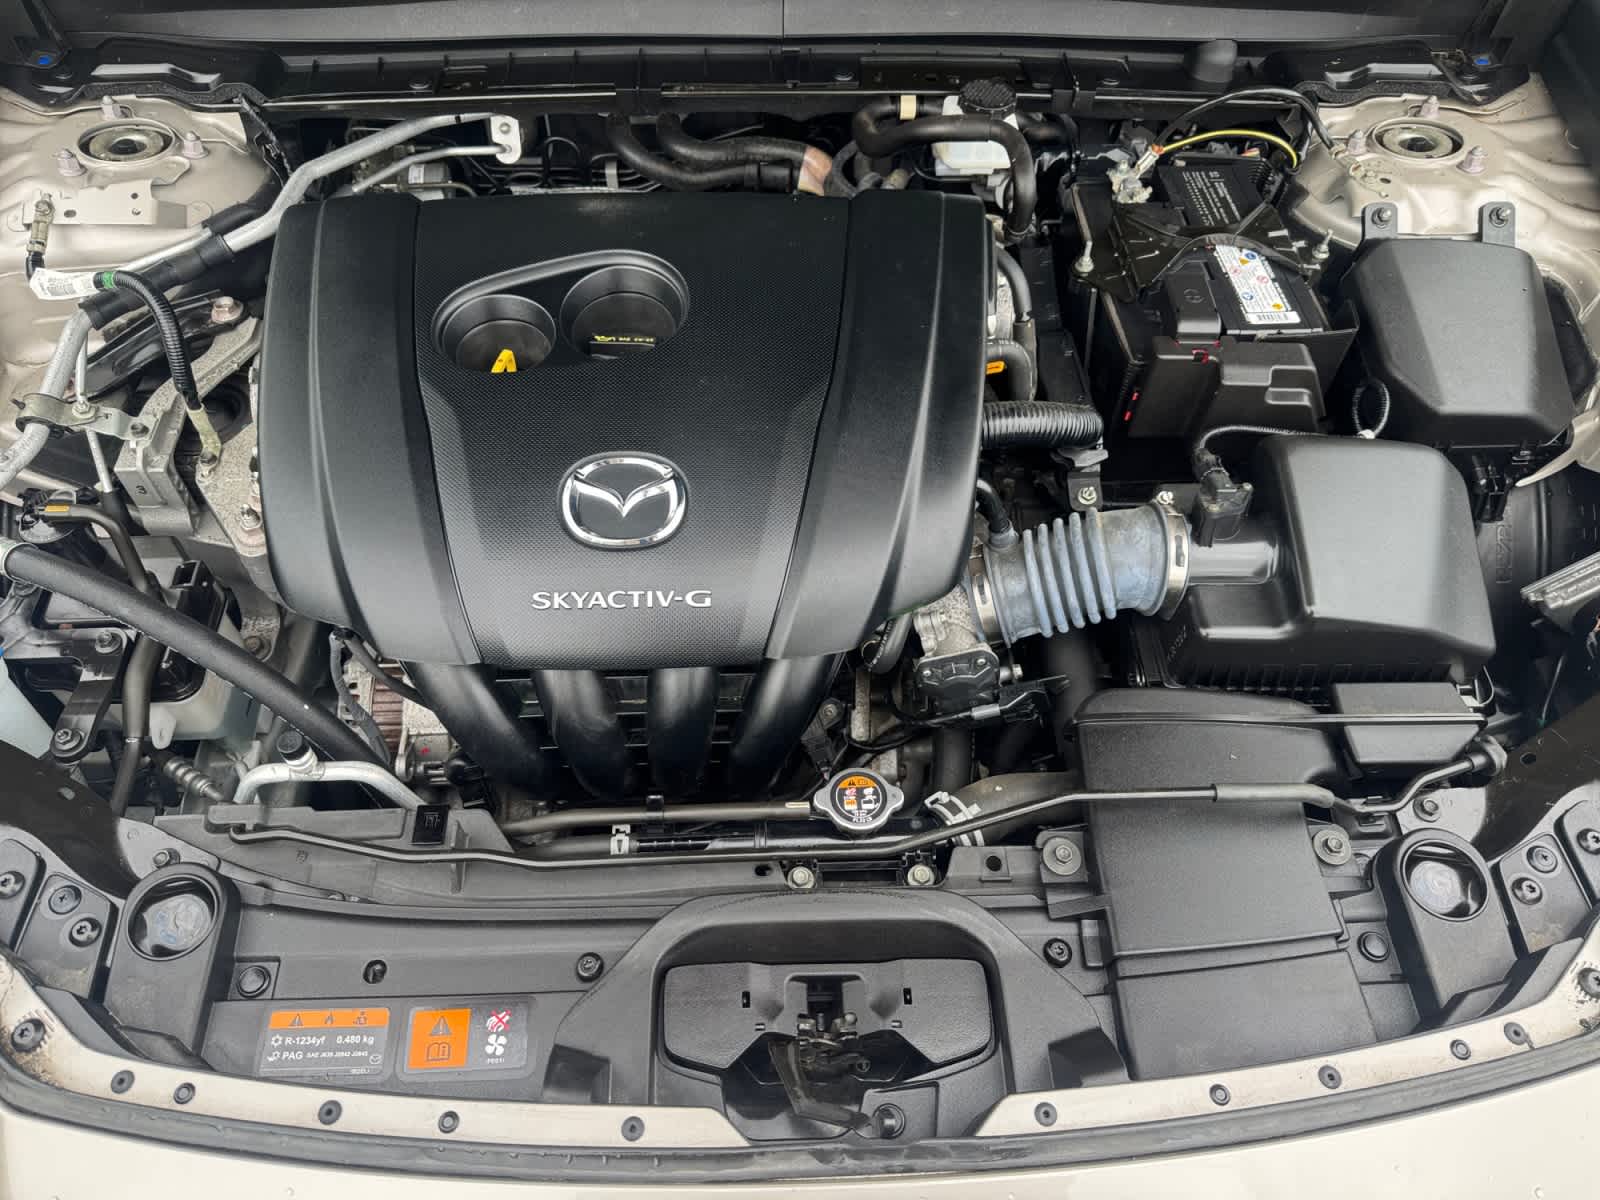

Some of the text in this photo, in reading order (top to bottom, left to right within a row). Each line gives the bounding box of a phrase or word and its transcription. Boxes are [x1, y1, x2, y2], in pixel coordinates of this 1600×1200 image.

[531, 590, 712, 610] SKYACTIV-G
[285, 1034, 375, 1047] R-1234yf 0.480 kg
[282, 1051, 304, 1061] PAG
